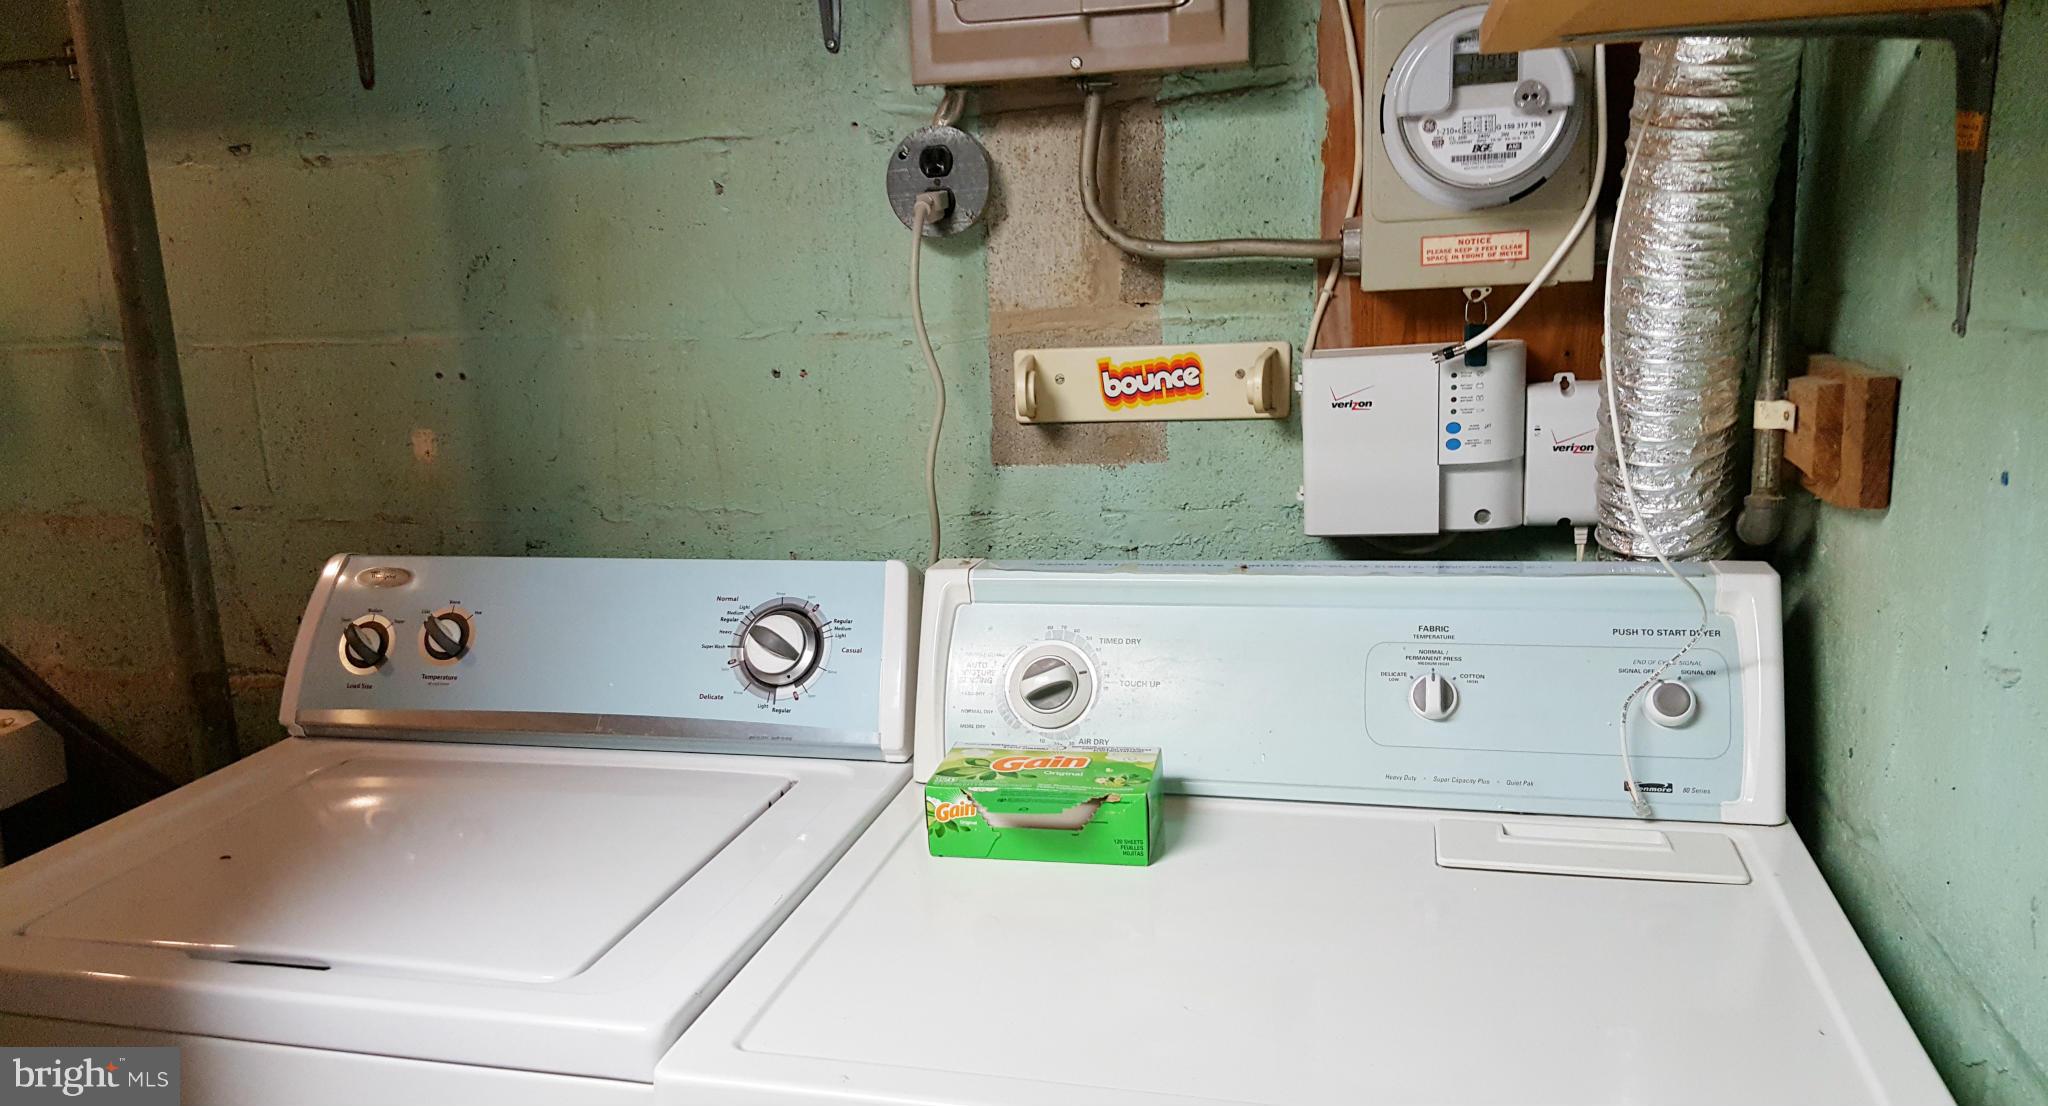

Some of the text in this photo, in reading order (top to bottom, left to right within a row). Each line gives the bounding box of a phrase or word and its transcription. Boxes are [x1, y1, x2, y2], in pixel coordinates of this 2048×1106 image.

[1472, 143, 1494, 153] BGE
[1101, 362, 1202, 401] bounce
[1331, 400, 1372, 410] verizon
[1552, 443, 1594, 454] verizon
[1612, 628, 1638, 636] PUSH
[992, 756, 1090, 772] Gain
[935, 800, 976, 822] Gain
